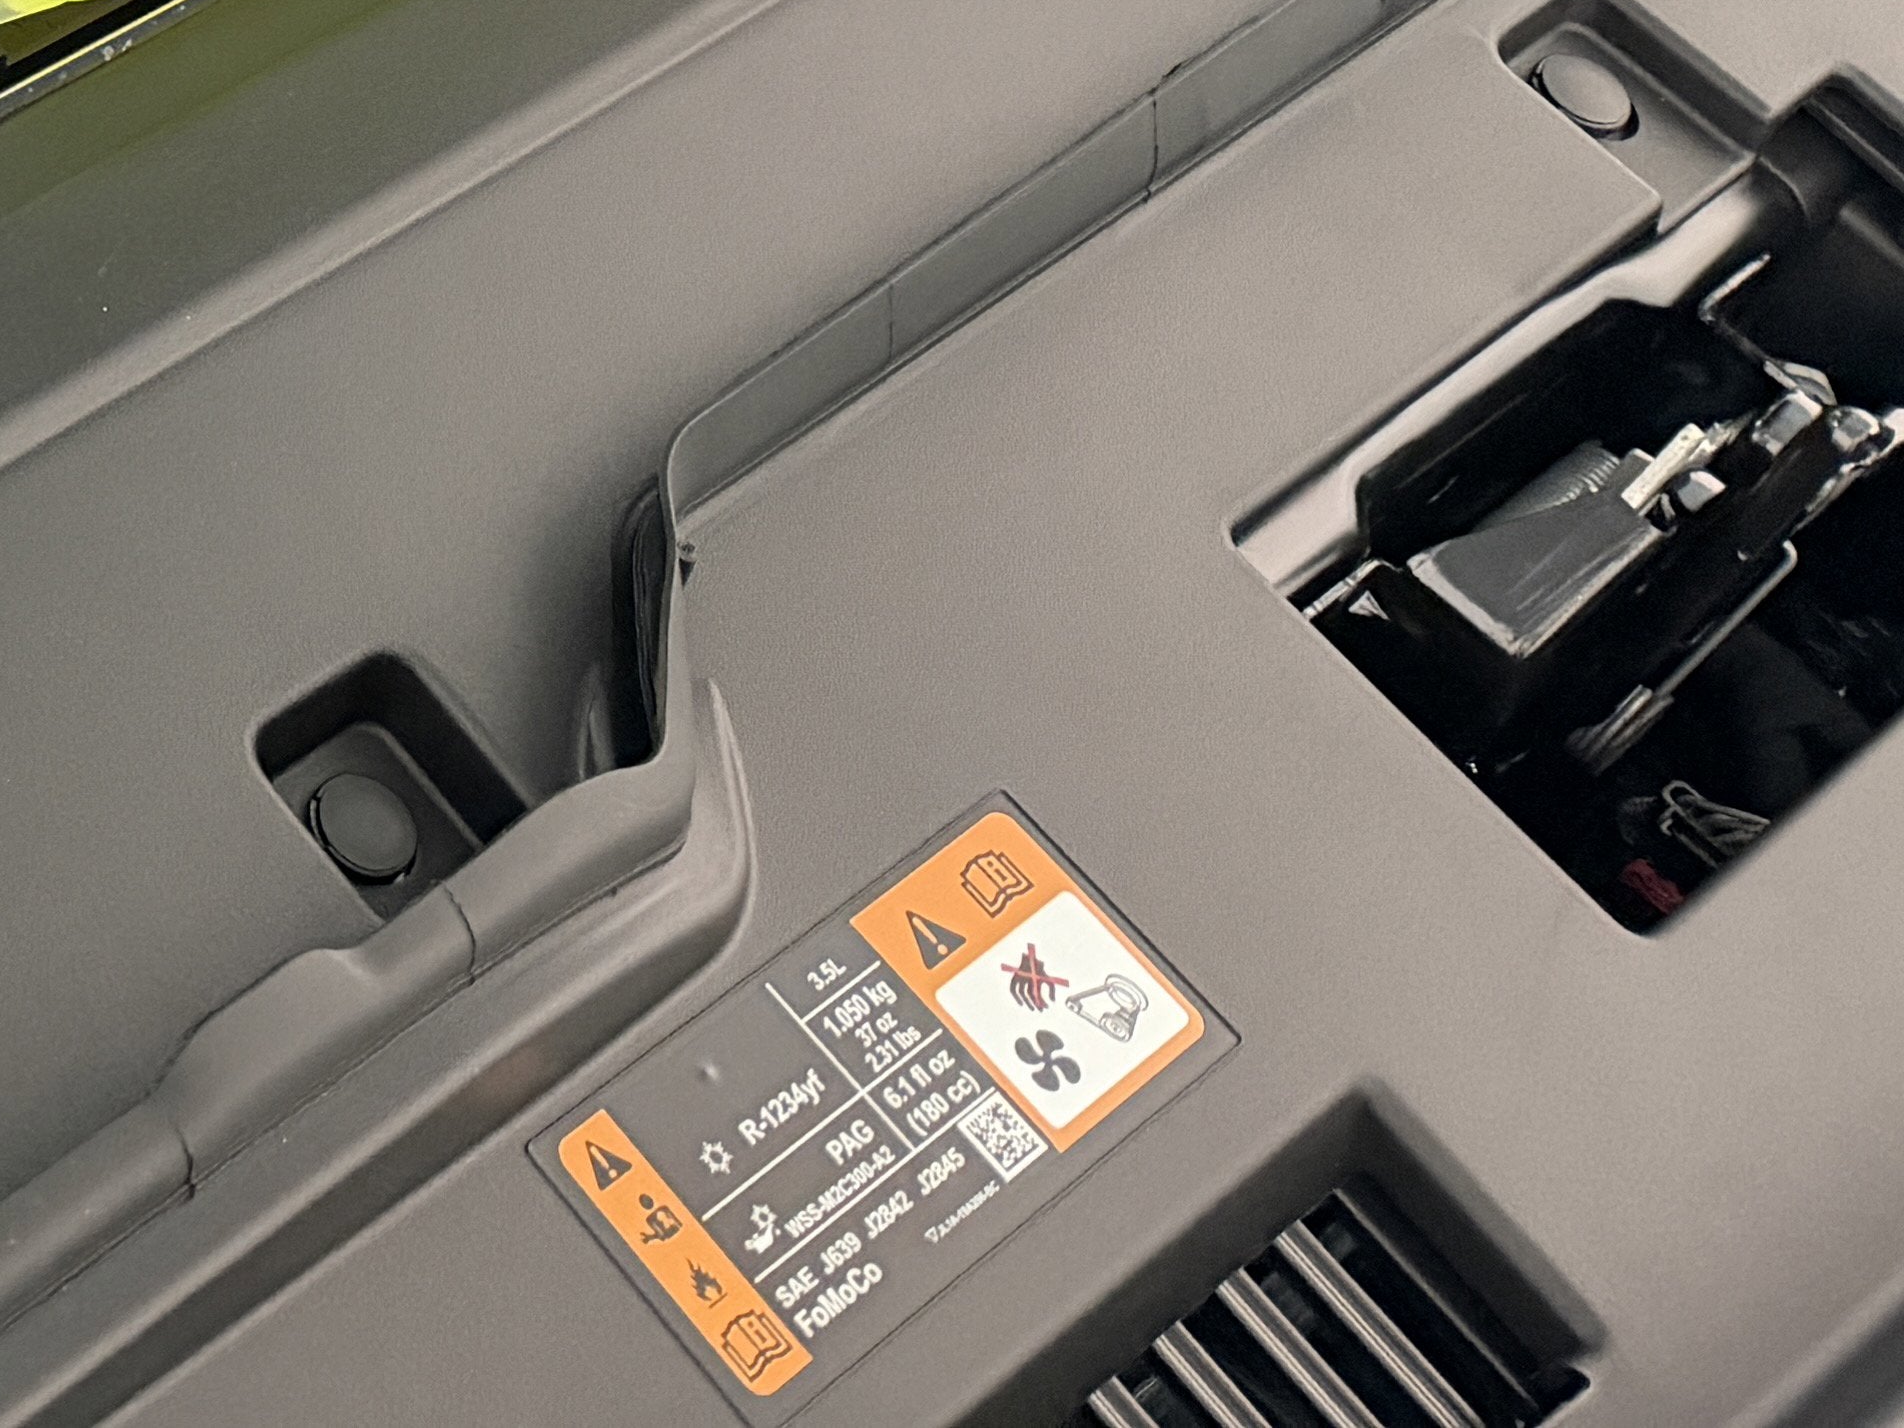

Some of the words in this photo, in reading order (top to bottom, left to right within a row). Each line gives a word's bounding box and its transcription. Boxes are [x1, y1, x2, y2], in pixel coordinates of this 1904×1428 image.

[807, 955, 846, 991] 3.5L
[820, 991, 872, 1039] 1.050
[863, 977, 898, 1012] kg
[854, 1022, 879, 1048] 37
[874, 1011, 897, 1033] oz
[863, 1039, 900, 1074] 2.31
[892, 1021, 921, 1050] lbs
[738, 1068, 829, 1151] R-1234yf
[882, 1075, 917, 1110] 6.1
[909, 1063, 931, 1086] fl
[926, 1048, 954, 1076] oz
[905, 1092, 954, 1139] (180
[943, 1068, 982, 1107] cc)
[826, 1118, 875, 1165] PAG
[785, 1144, 896, 1240] WSS-M2C300-A2
[774, 1264, 818, 1309] SAE
[816, 1228, 863, 1276] J639
[860, 1188, 914, 1239] J2842
[913, 1145, 967, 1196] J2845
[796, 1256, 884, 1338] FoMoCo
